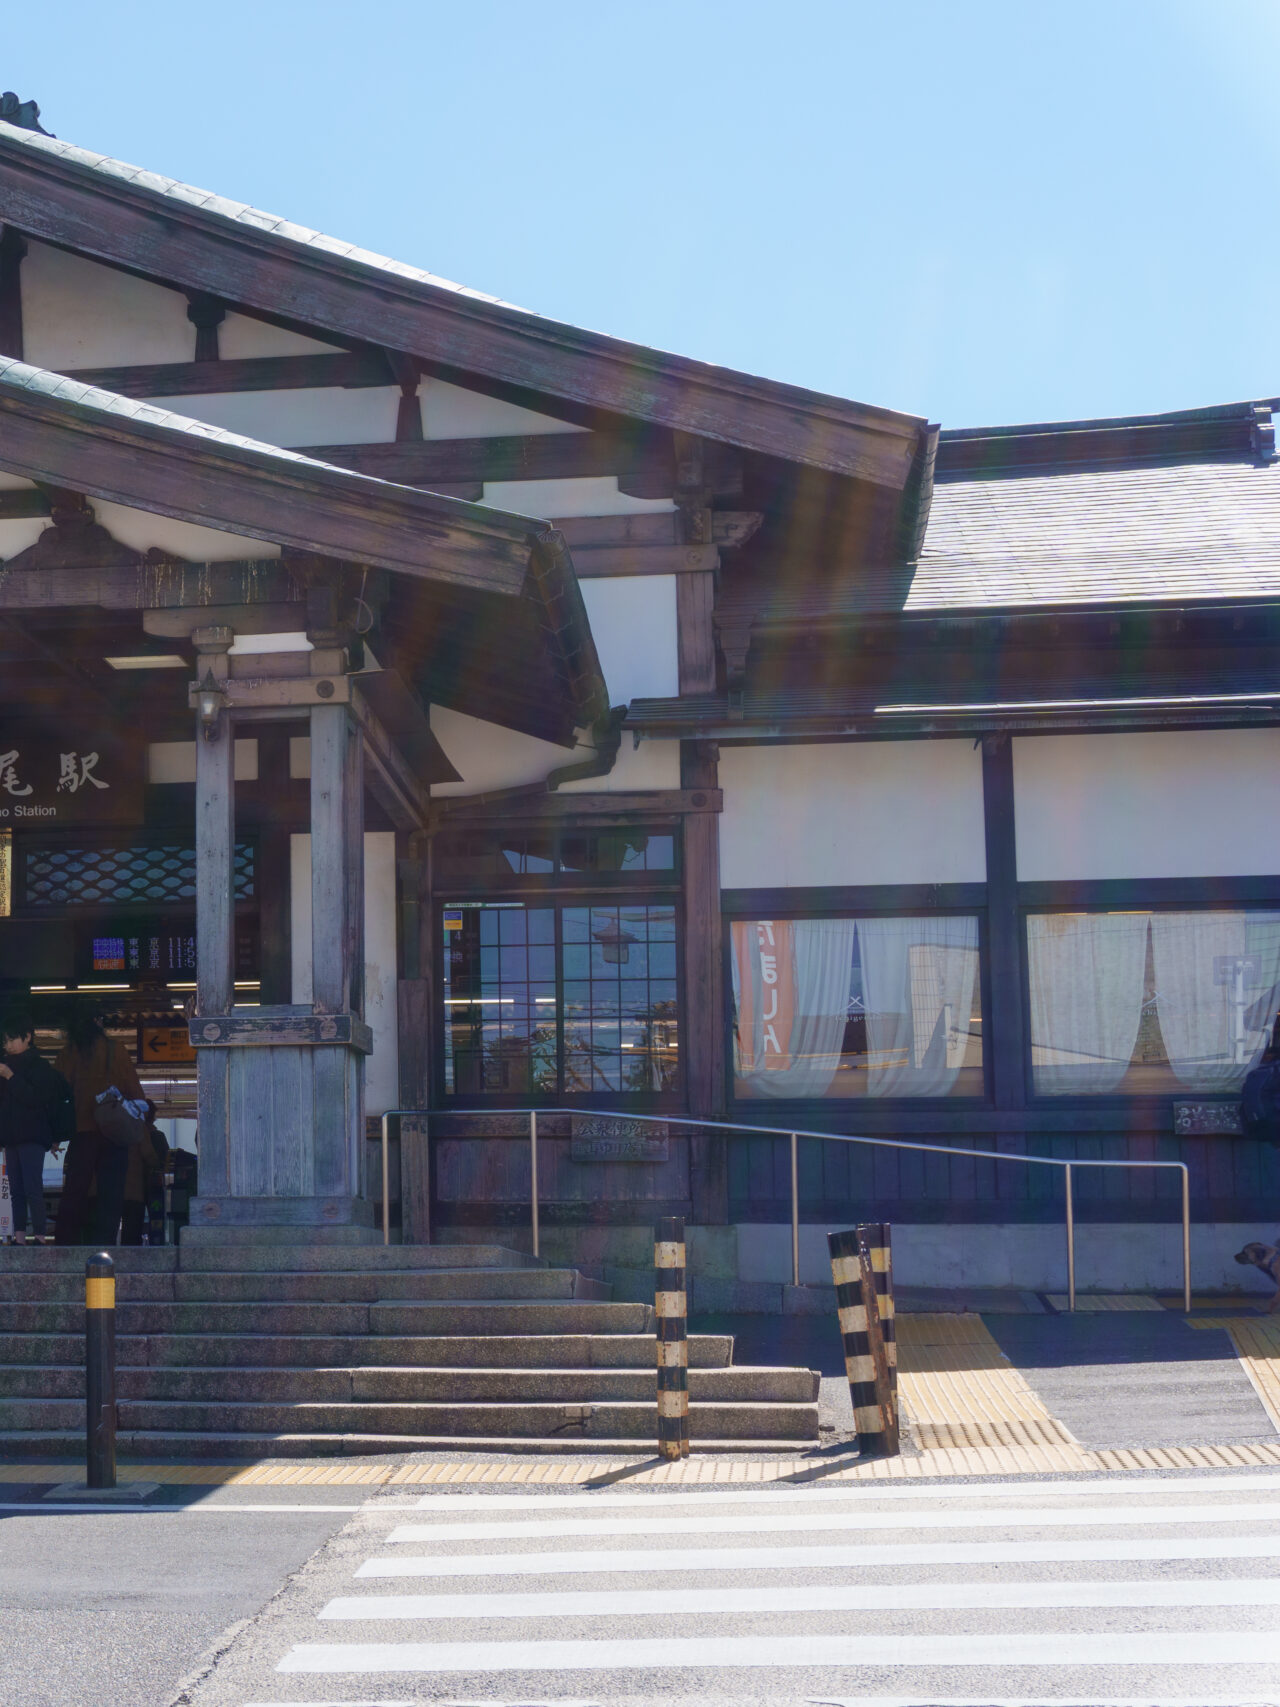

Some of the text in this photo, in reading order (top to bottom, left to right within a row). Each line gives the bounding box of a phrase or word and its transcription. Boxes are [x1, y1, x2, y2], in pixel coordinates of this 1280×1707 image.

[14, 804, 57, 818] Station
[128, 938, 160, 949] 東京
[168, 938, 195, 948] 11:4
[128, 948, 160, 959] 東京
[168, 948, 196, 958] 11:5
[128, 958, 160, 969] 東京
[168, 958, 196, 968] 11:5
[0, 1177, 9, 1200] たかお
